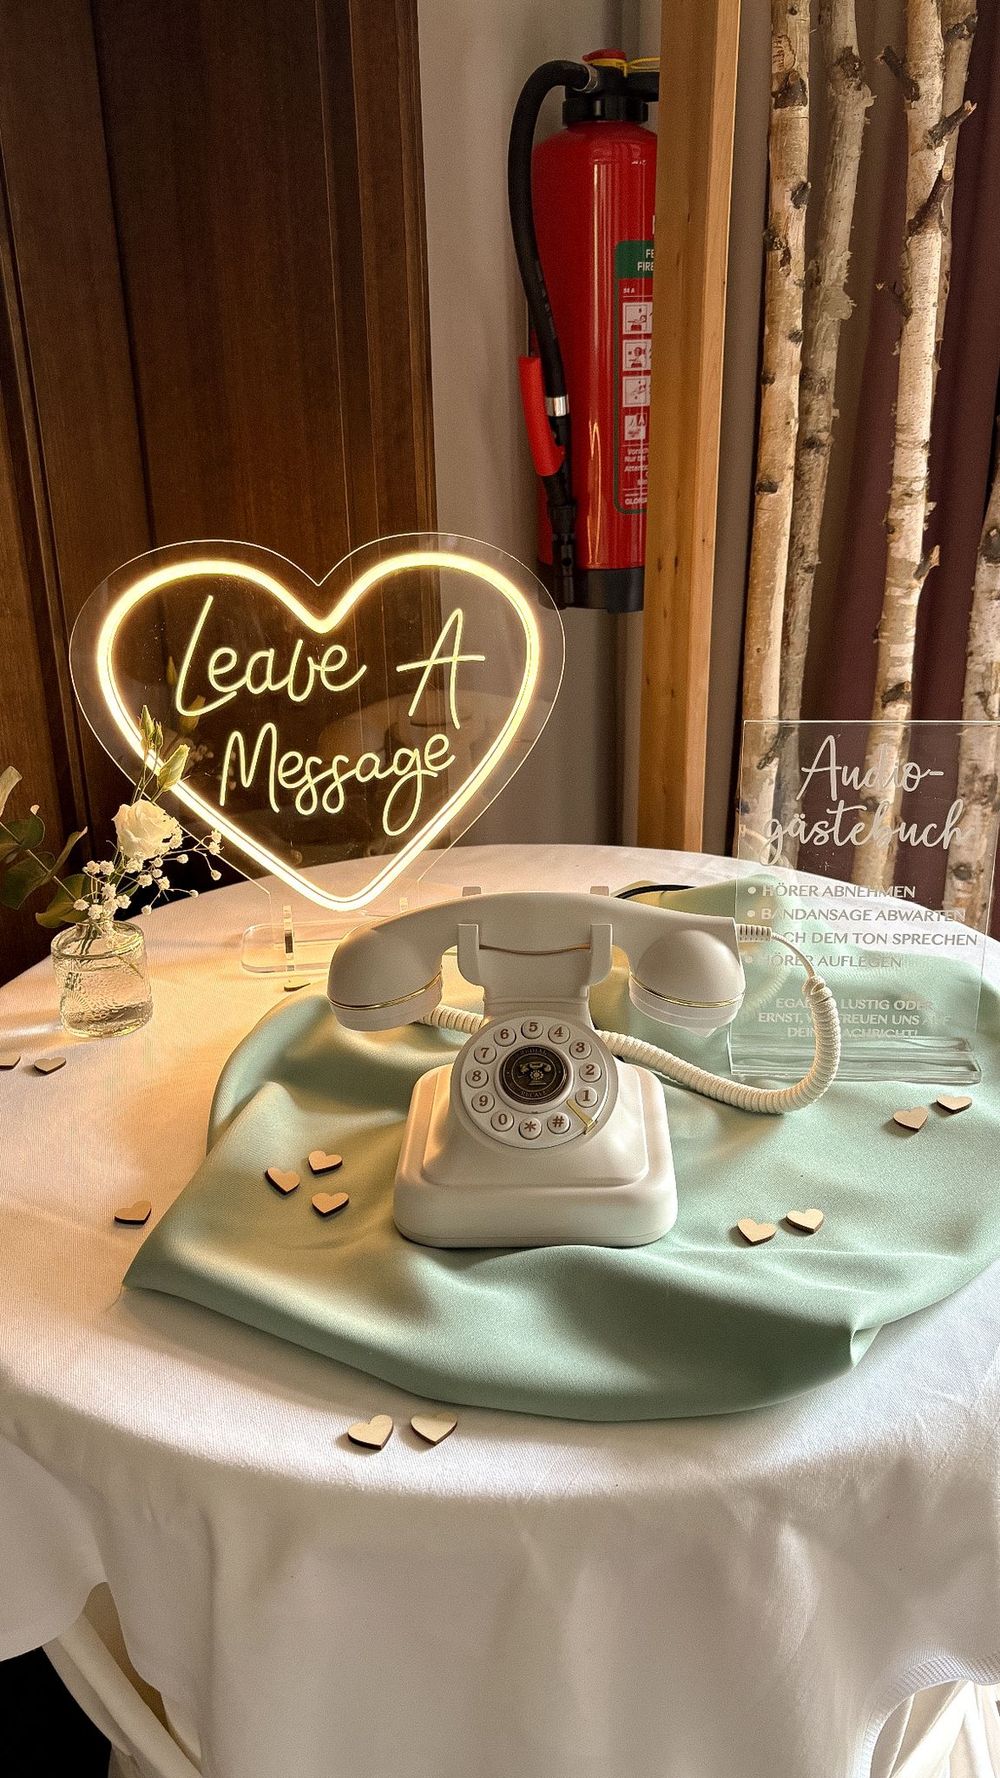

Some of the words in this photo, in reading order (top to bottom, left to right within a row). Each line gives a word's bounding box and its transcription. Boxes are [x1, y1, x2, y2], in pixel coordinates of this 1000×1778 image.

[176, 595, 367, 717] Leave
[396, 607, 485, 730] A
[796, 734, 944, 801] Audio-
[219, 722, 456, 837] Message
[760, 798, 968, 866] gästebuch
[762, 882, 819, 897] HÖRER
[821, 885, 916, 899] ABNEHMEN
[761, 908, 872, 921] BANDANSAGE
[875, 908, 966, 922] ABWARTEN
[812, 932, 848, 944] DEM
[852, 933, 888, 945] TON
[892, 933, 978, 946] SPRECHEN
[817, 955, 901, 968] AUFLEGEN
[841, 998, 890, 1010] LUSTIG
[758, 1012, 803, 1024] ERNST,
[892, 1014, 920, 1025] UNS
[529, 1022, 538, 1032] 5
[554, 1026, 563, 1037] 4
[500, 1028, 509, 1039] 6
[480, 1047, 489, 1058] 7
[575, 1042, 585, 1053] 3
[472, 1070, 482, 1081] 8
[585, 1064, 595, 1075] 2
[479, 1095, 488, 1106] 9
[583, 1090, 590, 1101] 1
[552, 1115, 565, 1127] #
